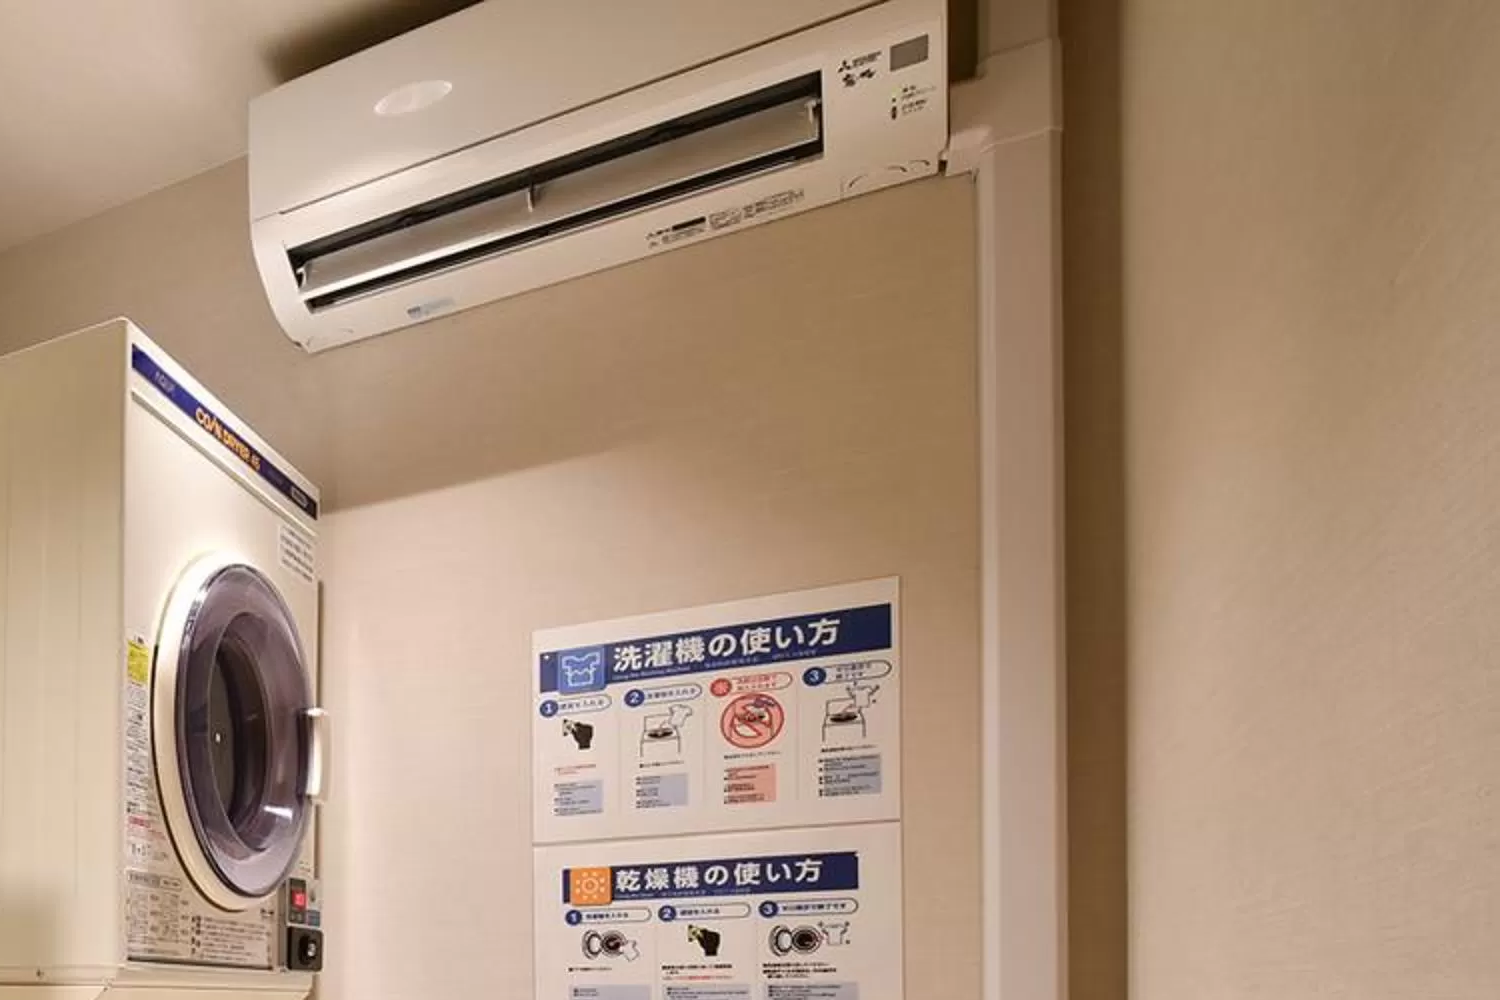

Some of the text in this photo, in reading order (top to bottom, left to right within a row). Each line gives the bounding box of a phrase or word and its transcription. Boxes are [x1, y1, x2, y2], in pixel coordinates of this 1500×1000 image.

[612, 618, 841, 673] 洗濯機の使い方
[615, 859, 823, 892] 乾燥機の使い方
